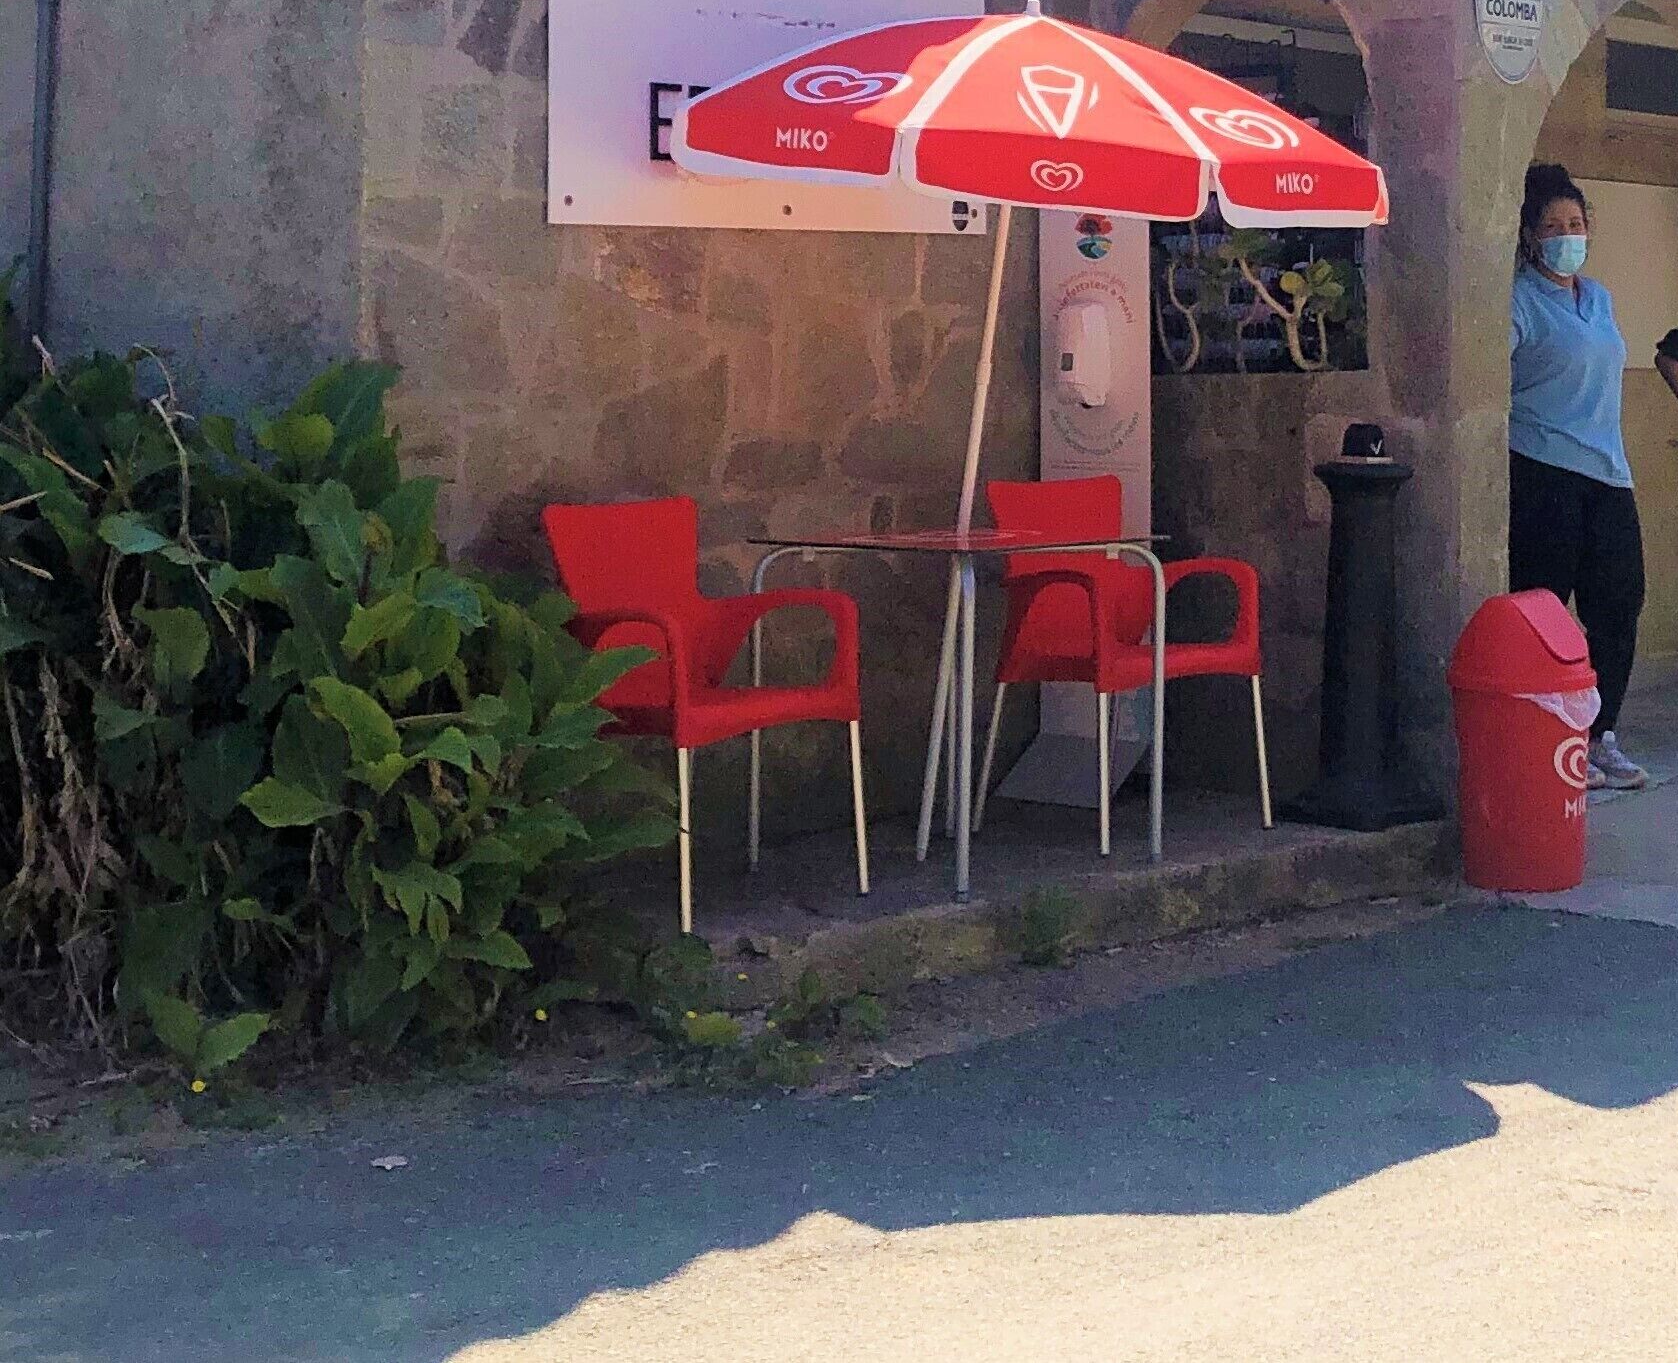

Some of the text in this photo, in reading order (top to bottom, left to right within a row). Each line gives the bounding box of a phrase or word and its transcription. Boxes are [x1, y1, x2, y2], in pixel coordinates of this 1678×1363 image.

[650, 81, 711, 161] E
[775, 127, 828, 152] MIKO
[1275, 172, 1314, 195] MIKO
